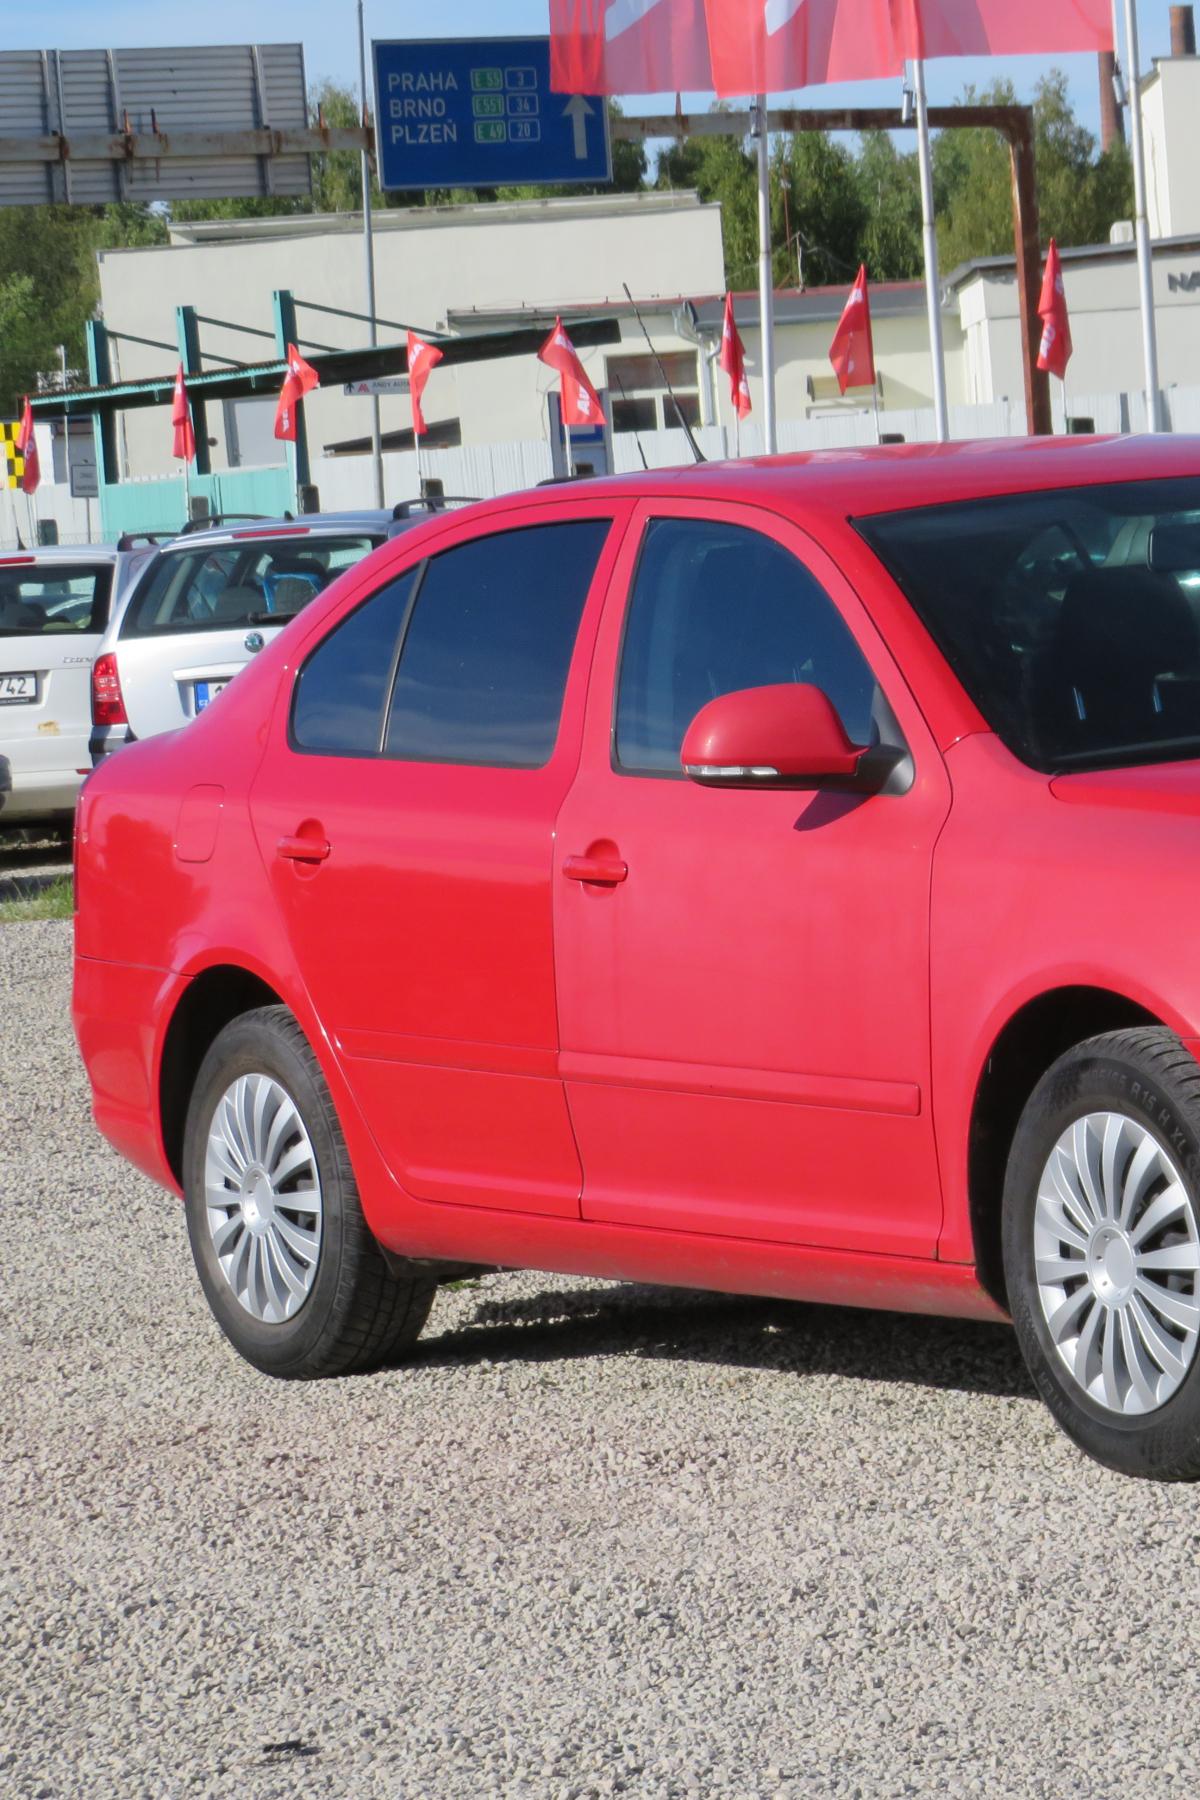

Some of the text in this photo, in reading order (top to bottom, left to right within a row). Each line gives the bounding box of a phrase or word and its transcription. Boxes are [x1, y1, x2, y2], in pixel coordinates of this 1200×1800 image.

[388, 71, 459, 92] PRAHA
[517, 71, 524, 86] 3
[389, 98, 446, 118] BRNO
[391, 118, 457, 144] PLZEŇ
[517, 122, 531, 137] 20
